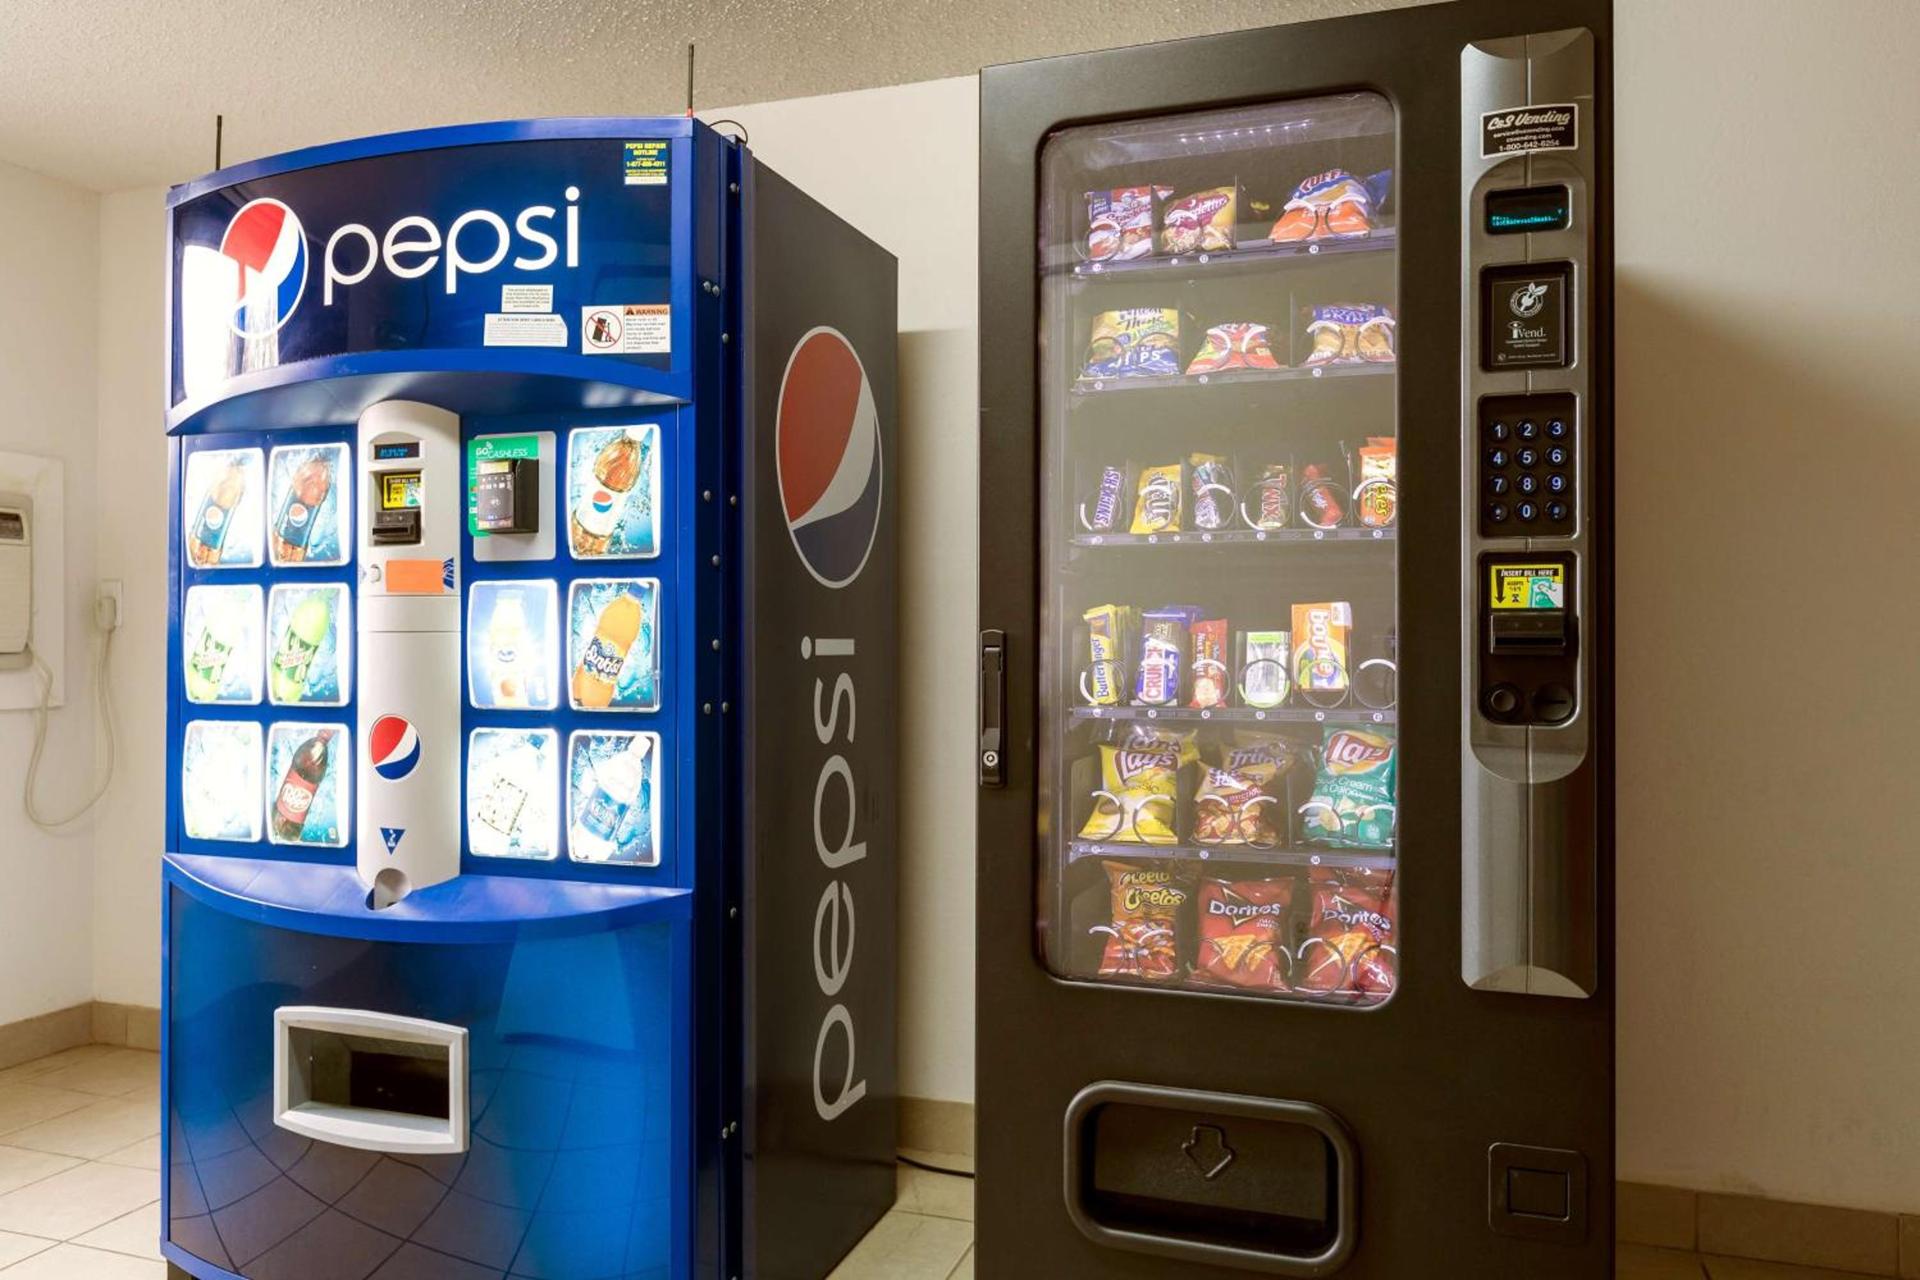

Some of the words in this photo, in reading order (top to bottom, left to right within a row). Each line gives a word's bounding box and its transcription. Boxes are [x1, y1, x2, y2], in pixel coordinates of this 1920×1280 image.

[1514, 110, 1571, 126] Vending
[324, 186, 580, 306] pepsi
[635, 308, 668, 316] WARNING
[1494, 424, 1502, 438] 1
[1523, 423, 1532, 436] 2
[1552, 421, 1562, 435] 3
[475, 447, 489, 456] GO
[1493, 451, 1502, 464] 4
[1523, 450, 1532, 463] 5
[1552, 449, 1562, 462] 6
[1495, 478, 1503, 492] 7
[1523, 477, 1532, 490] 8
[1552, 476, 1561, 490] 9
[1522, 504, 1531, 517] 0
[1500, 568, 1522, 577] INSERT
[1538, 568, 1555, 577] HERE
[800, 635, 867, 1121] pepsi
[1209, 900, 1280, 916] Doritos
[1323, 909, 1391, 931] Doritos
